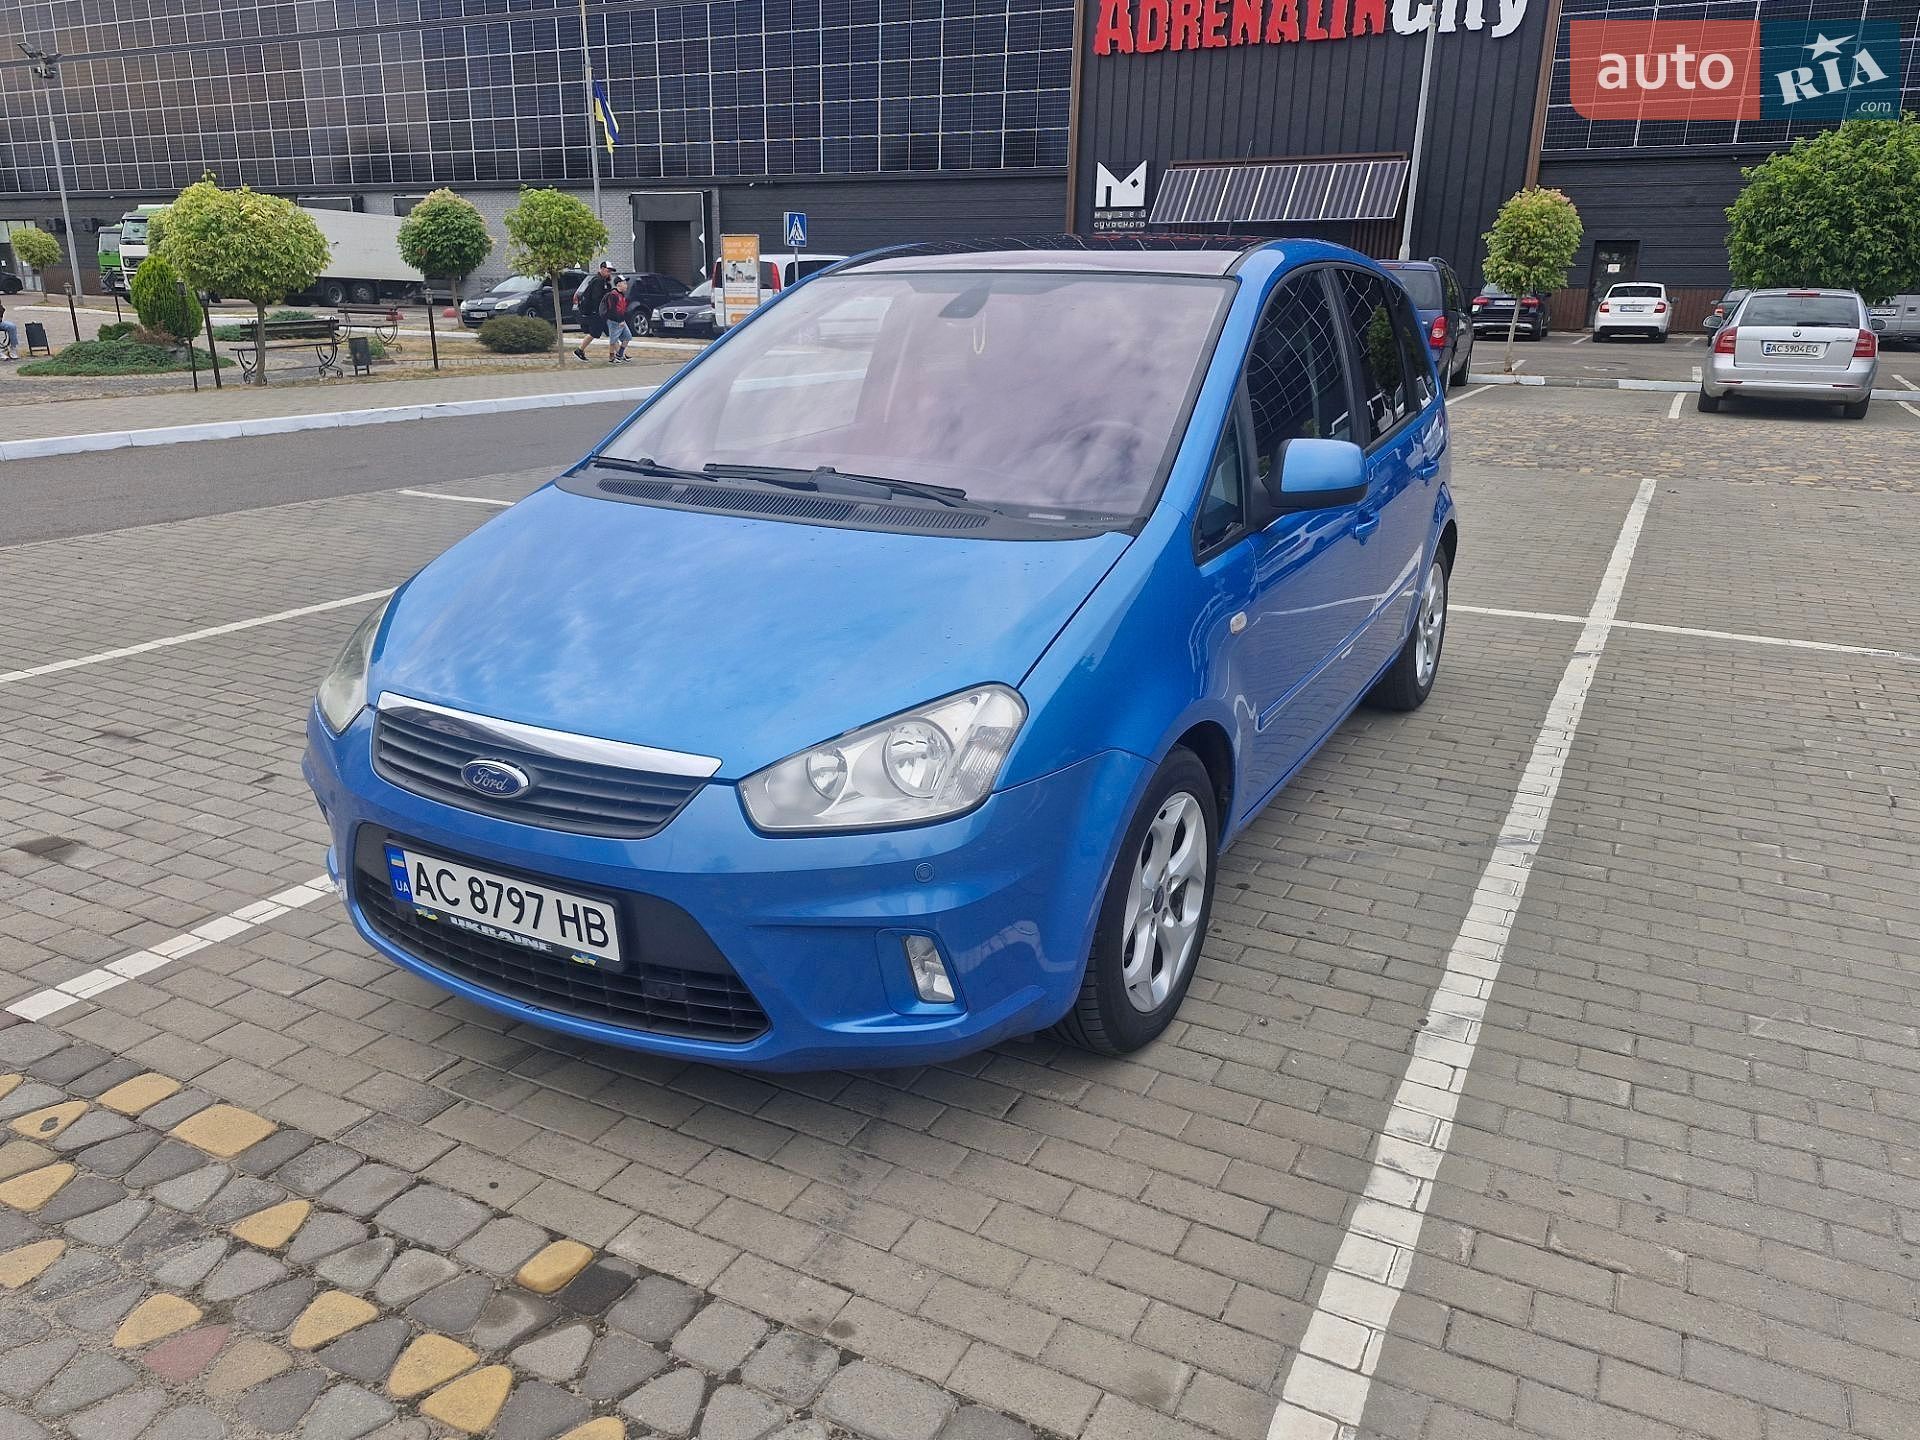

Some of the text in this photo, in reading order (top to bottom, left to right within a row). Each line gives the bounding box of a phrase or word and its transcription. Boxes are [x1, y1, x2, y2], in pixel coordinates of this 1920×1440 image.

[1093, 0, 1387, 55] ADRENALIN
[473, 767, 509, 791] Ford
[395, 880, 410, 894] UA
[416, 862, 609, 948] AC 8797 HB
